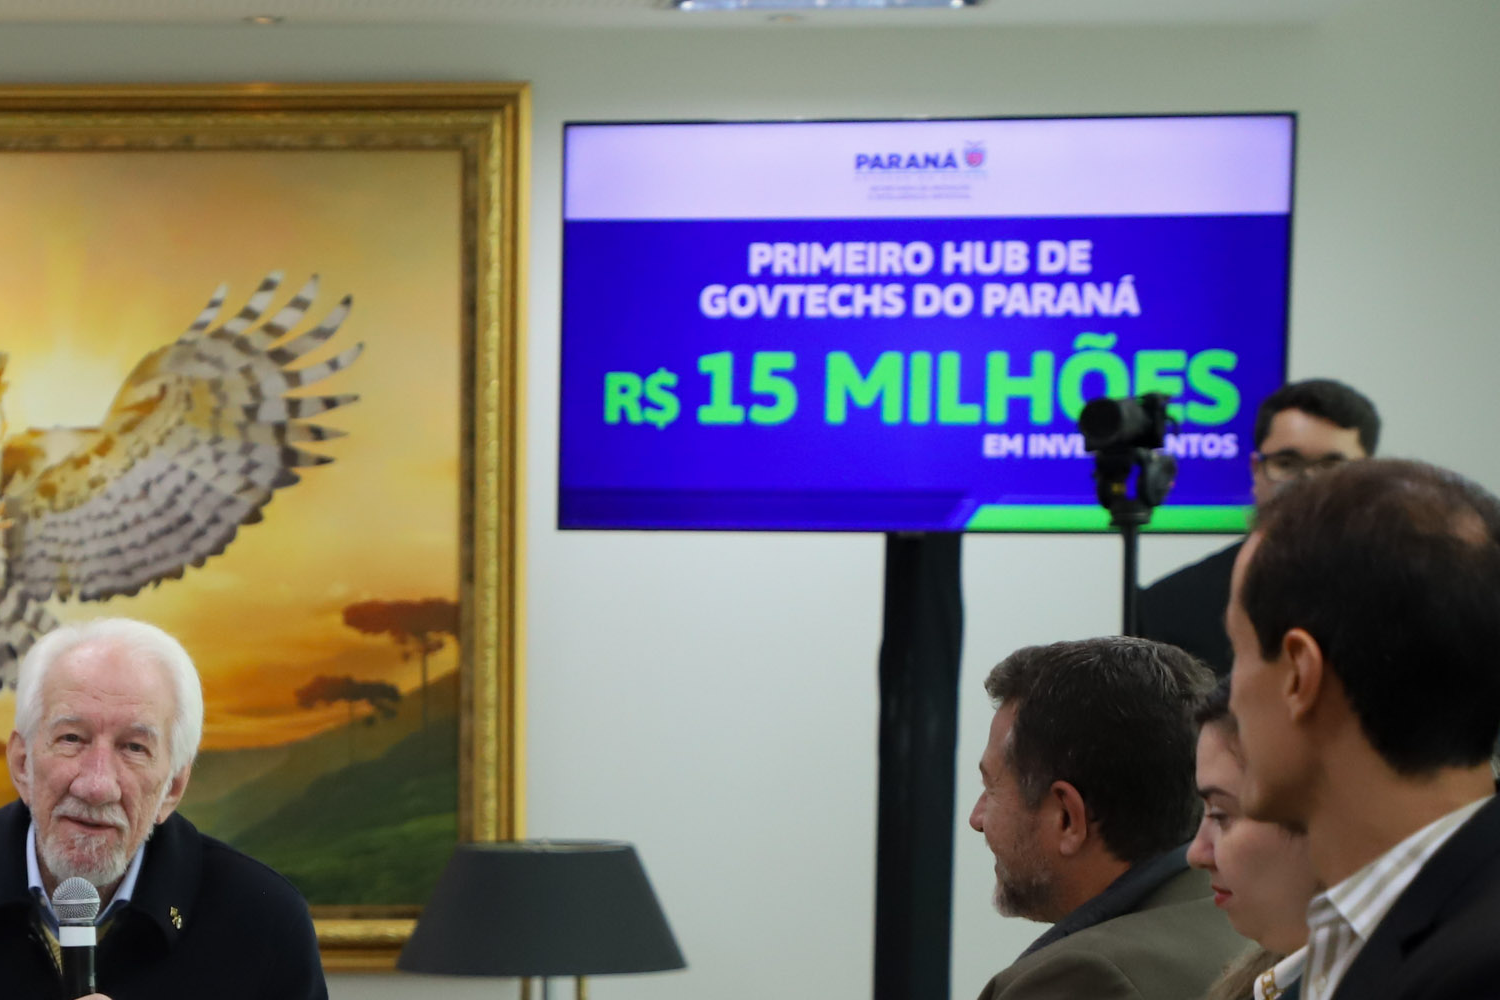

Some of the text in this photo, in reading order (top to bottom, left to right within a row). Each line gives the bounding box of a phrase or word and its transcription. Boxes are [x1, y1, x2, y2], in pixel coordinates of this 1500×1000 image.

[854, 148, 959, 170] PARANÁ
[747, 239, 1093, 277] PRIMEIRO HUB DE
[699, 274, 1141, 319] GOVTECHS DO PARANÁ
[603, 366, 681, 430] R$
[696, 350, 799, 426] 15
[982, 432, 1239, 459] EM INVENTOS
